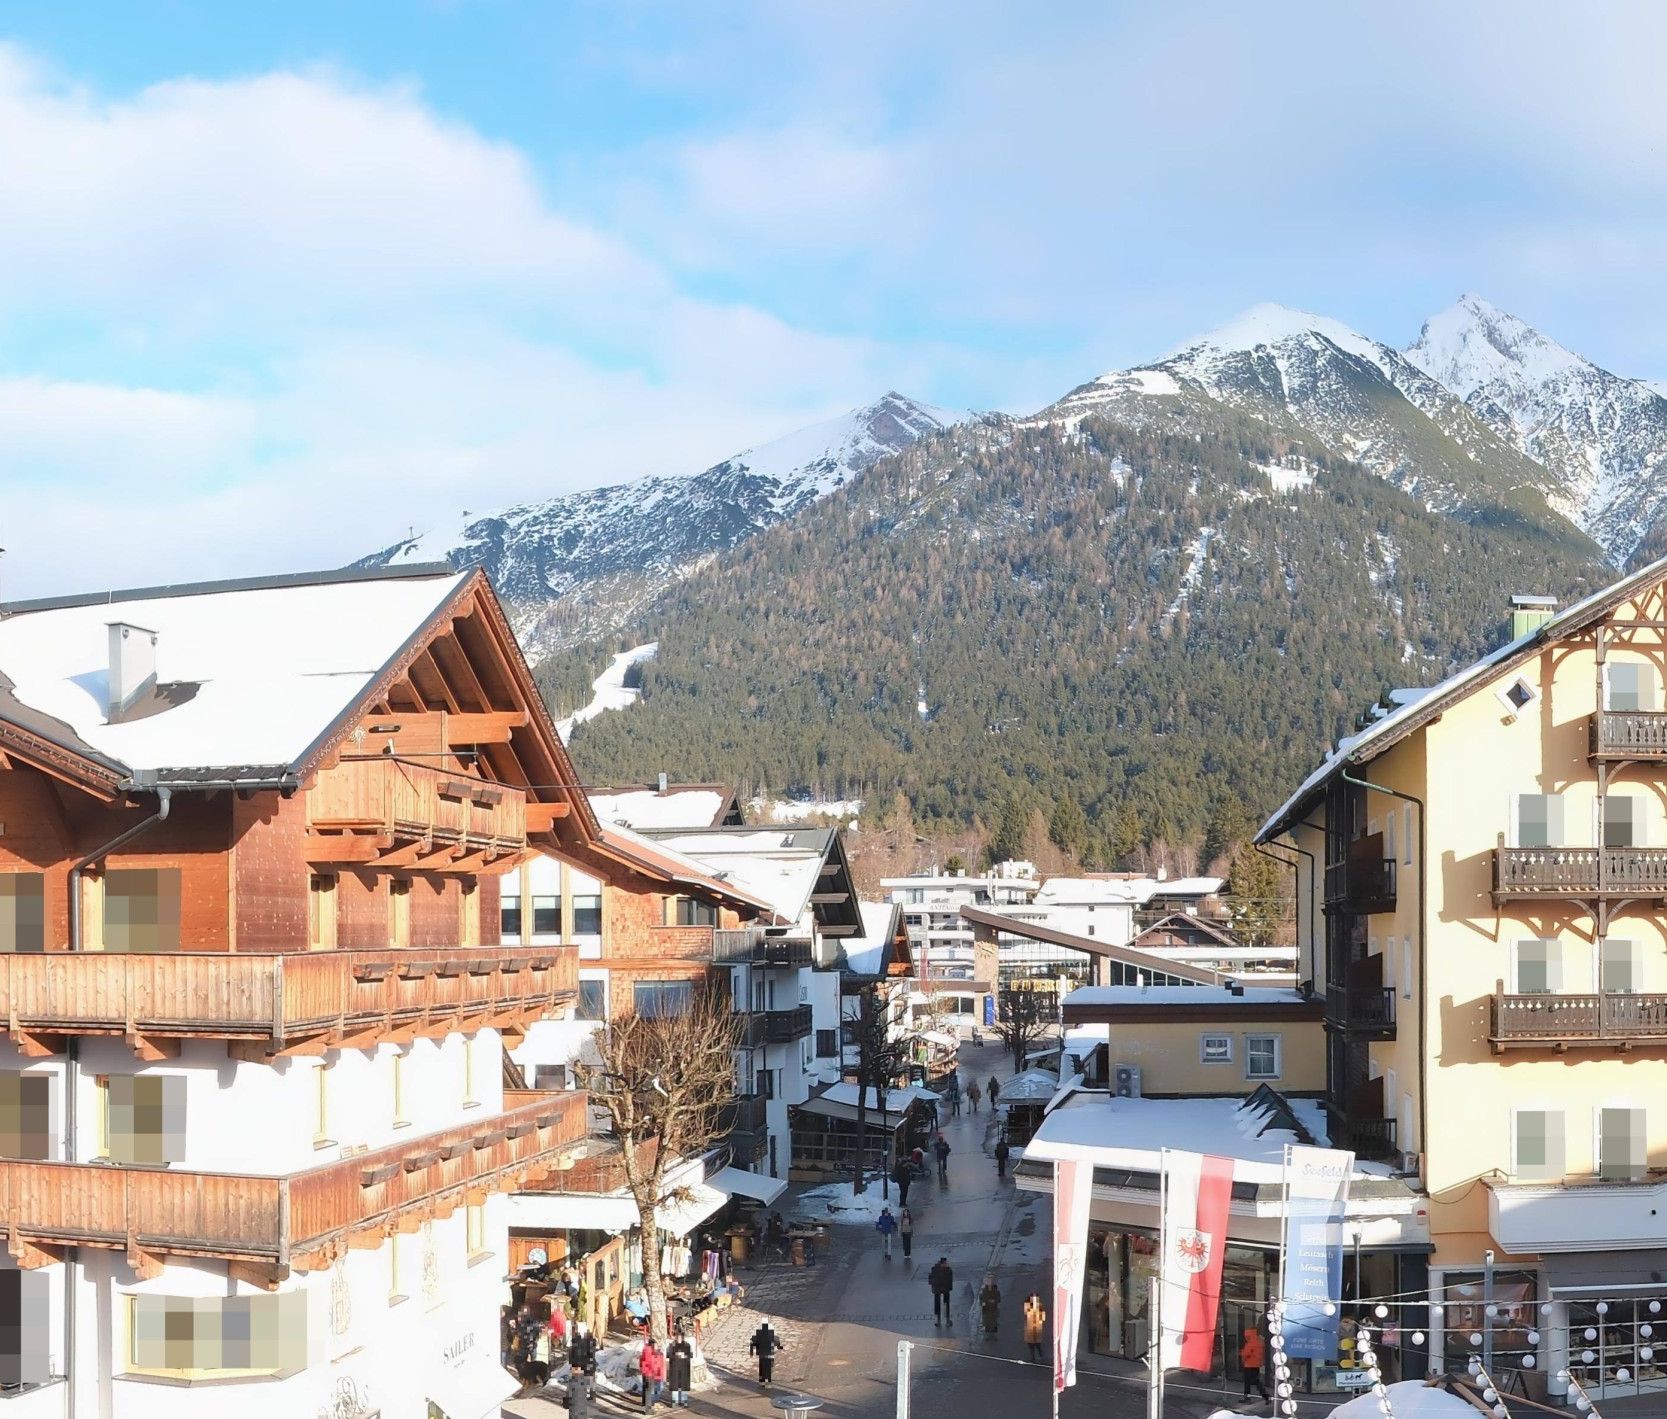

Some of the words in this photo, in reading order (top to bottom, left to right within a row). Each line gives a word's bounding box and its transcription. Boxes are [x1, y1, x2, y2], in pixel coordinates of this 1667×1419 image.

[1302, 1163, 1342, 1178] Seefeld
[1303, 1278, 1325, 1288] Reith
[443, 1332, 475, 1365] SAILER
